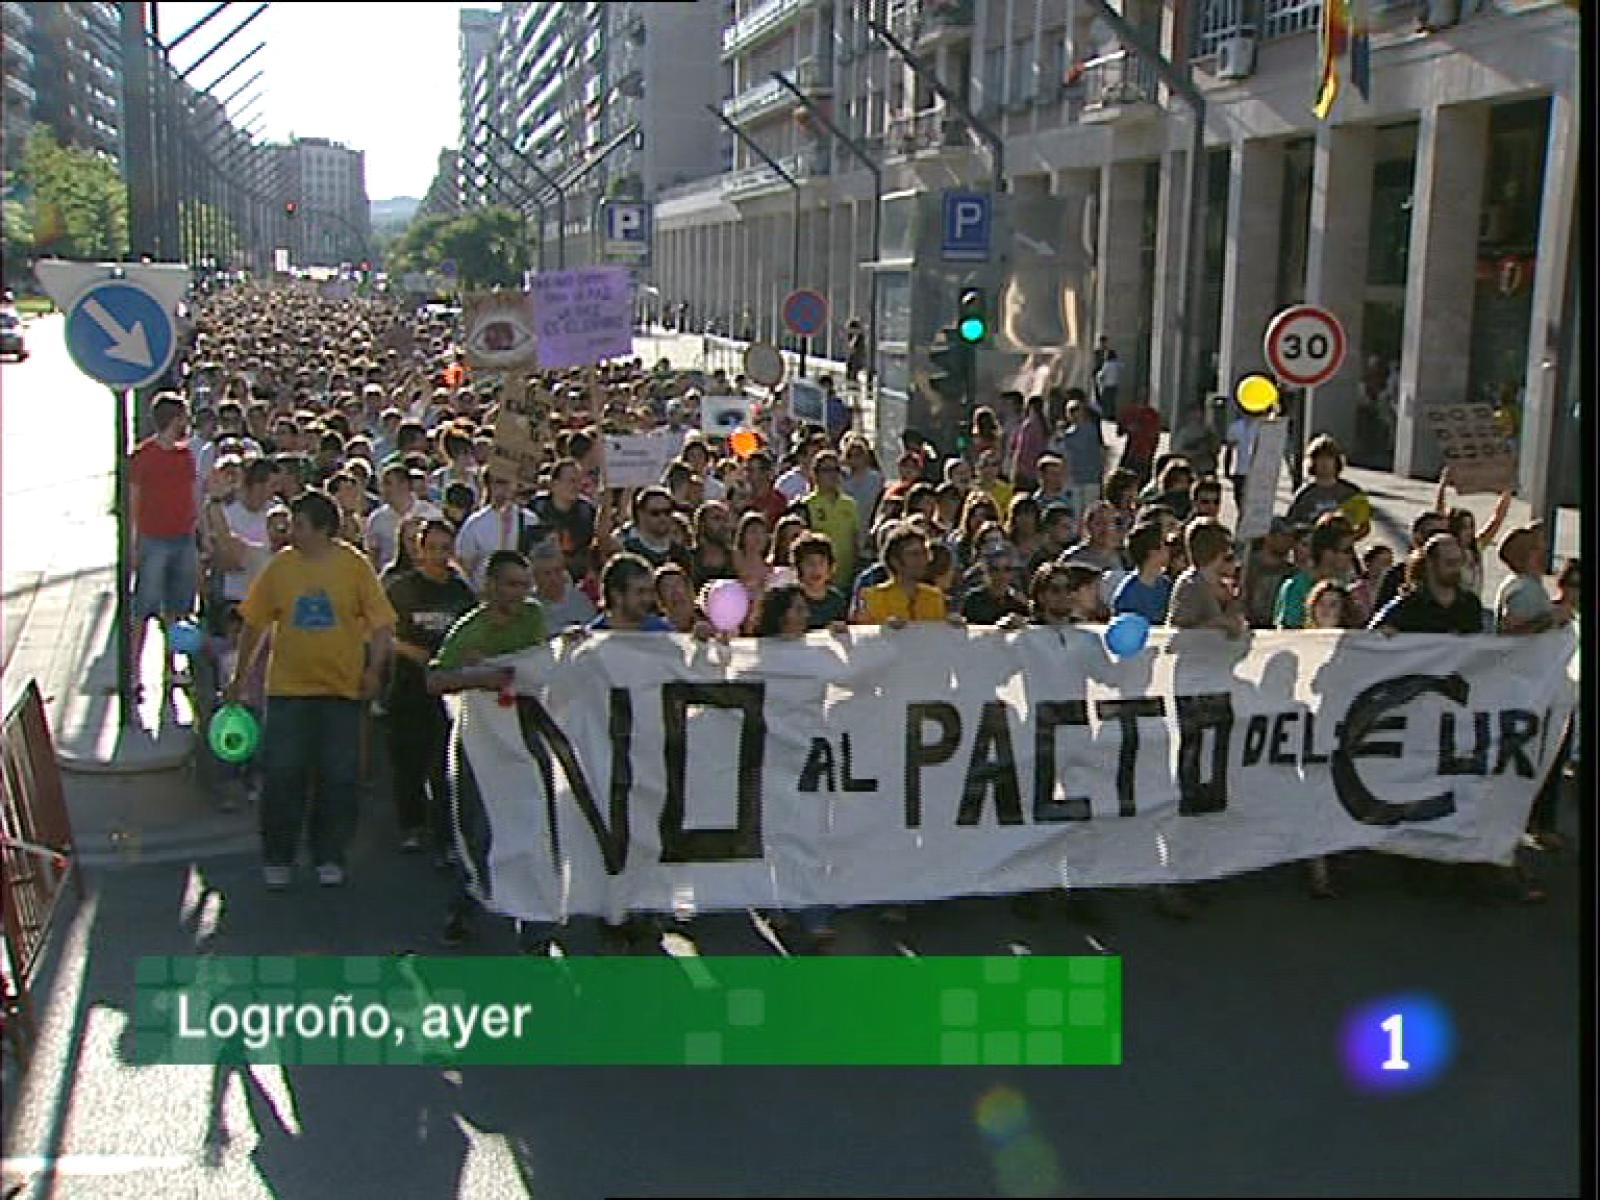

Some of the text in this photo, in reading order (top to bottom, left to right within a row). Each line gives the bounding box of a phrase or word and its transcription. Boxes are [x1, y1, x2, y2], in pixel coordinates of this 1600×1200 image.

[614, 206, 640, 239] P
[955, 202, 982, 238] P
[1283, 334, 1329, 360] 30
[516, 674, 1551, 876] NO AL PACTO DEL €UR
